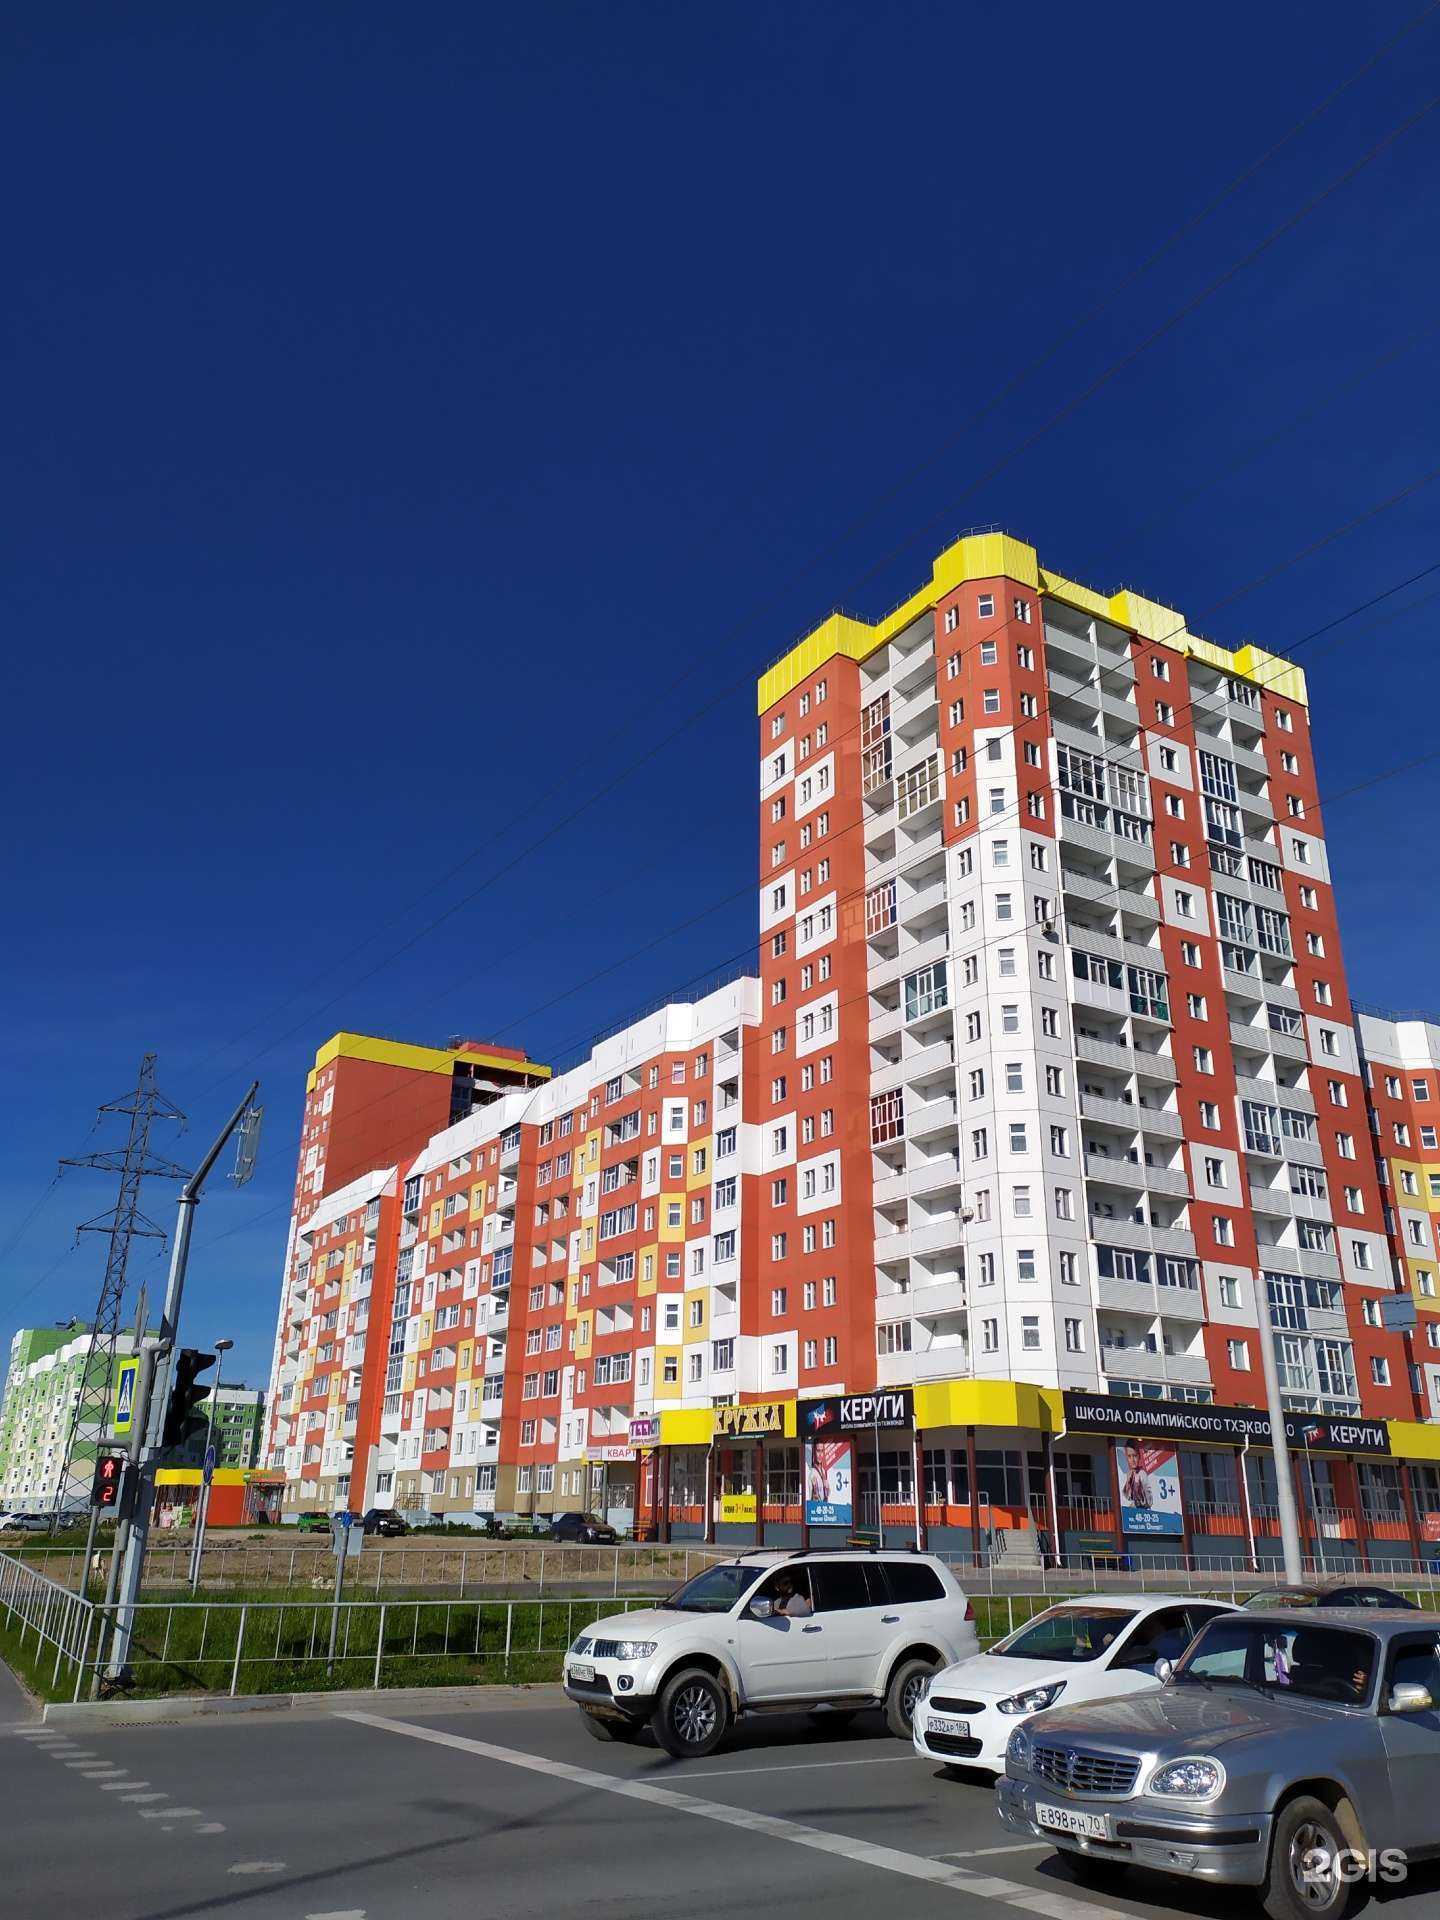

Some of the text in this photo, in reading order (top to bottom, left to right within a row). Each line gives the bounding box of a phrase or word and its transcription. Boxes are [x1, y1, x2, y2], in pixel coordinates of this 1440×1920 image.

[840, 1394, 905, 1423] КЕРУГИ
[713, 1405, 781, 1436] КРУЖКА
[1075, 1406, 1295, 1437] ШКОЛА ОЛИМПИЙСКОГО ТХЭКВОО
[1329, 1424, 1385, 1447] КЕРУГИ
[836, 1471, 850, 1491] 3+
[1158, 1478, 1176, 1500] 3+
[103, 1486, 113, 1501] 2
